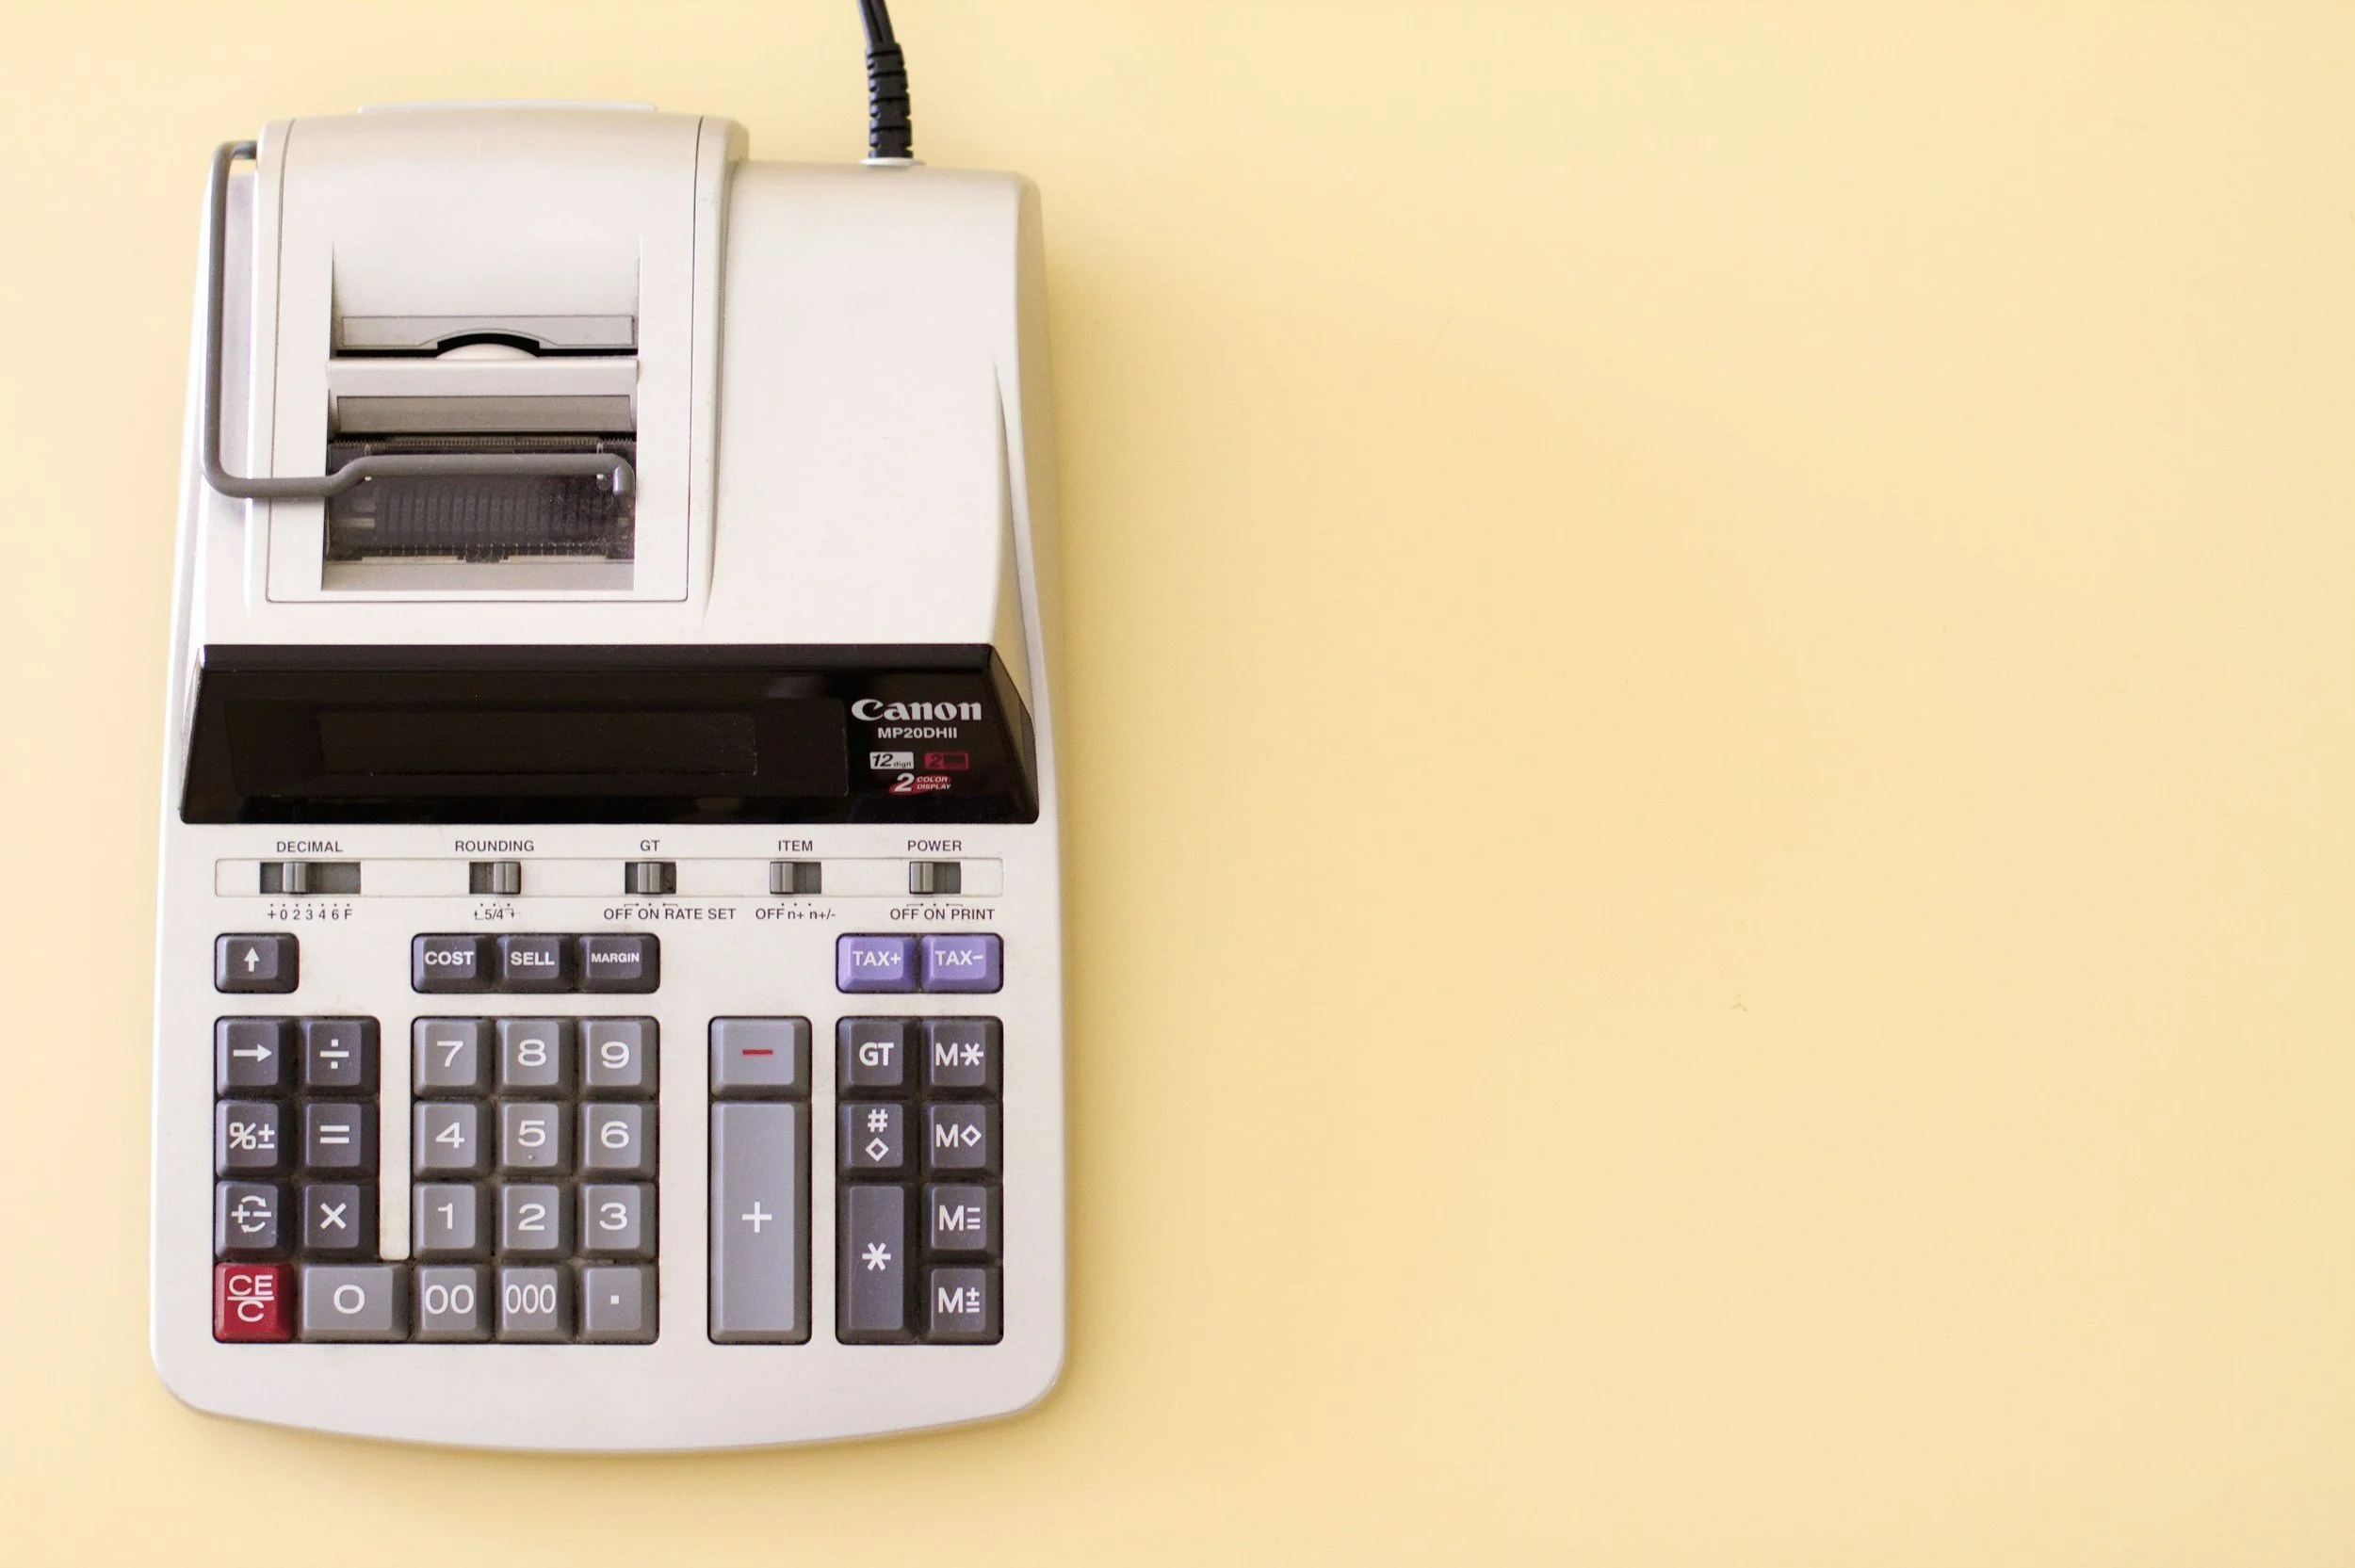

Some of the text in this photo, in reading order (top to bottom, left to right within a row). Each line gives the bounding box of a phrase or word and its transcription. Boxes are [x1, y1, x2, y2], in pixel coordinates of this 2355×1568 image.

[851, 699, 982, 721] Canon
[877, 727, 958, 739] MP20DHII
[872, 754, 913, 770] 12 digit
[894, 772, 915, 792] 2
[276, 841, 343, 853] DECIMAL
[455, 840, 534, 852] ROUNDING
[640, 839, 660, 852] GT
[778, 840, 813, 851] ITEM
[907, 839, 962, 852] POWER
[292, 909, 300, 920] 2
[305, 909, 314, 920] 3
[318, 909, 326, 920] 4
[331, 909, 339, 920] 6
[344, 909, 352, 920] F
[603, 908, 737, 920] OFF ON RATE SET
[755, 908, 785, 920] OFF
[788, 911, 804, 920] n+
[889, 908, 994, 920] OFF ON PRINT
[424, 951, 475, 966] COST
[511, 951, 556, 966] SELL
[591, 952, 640, 963] MARGIN
[852, 950, 901, 967] TAX+
[436, 1040, 464, 1067] 7
[517, 1039, 547, 1067] 8
[600, 1041, 630, 1069] 9
[859, 1042, 895, 1067] GT
[435, 1122, 465, 1149] 4
[518, 1120, 546, 1147] 5
[600, 1121, 630, 1149] 6
[437, 1203, 453, 1230] 1
[518, 1203, 546, 1231] 2
[599, 1202, 628, 1231] 3
[229, 1274, 273, 1297] CE
[333, 1284, 365, 1315] 0
[424, 1284, 475, 1315] 00
[505, 1284, 557, 1314] 000
[236, 1299, 266, 1322] C
